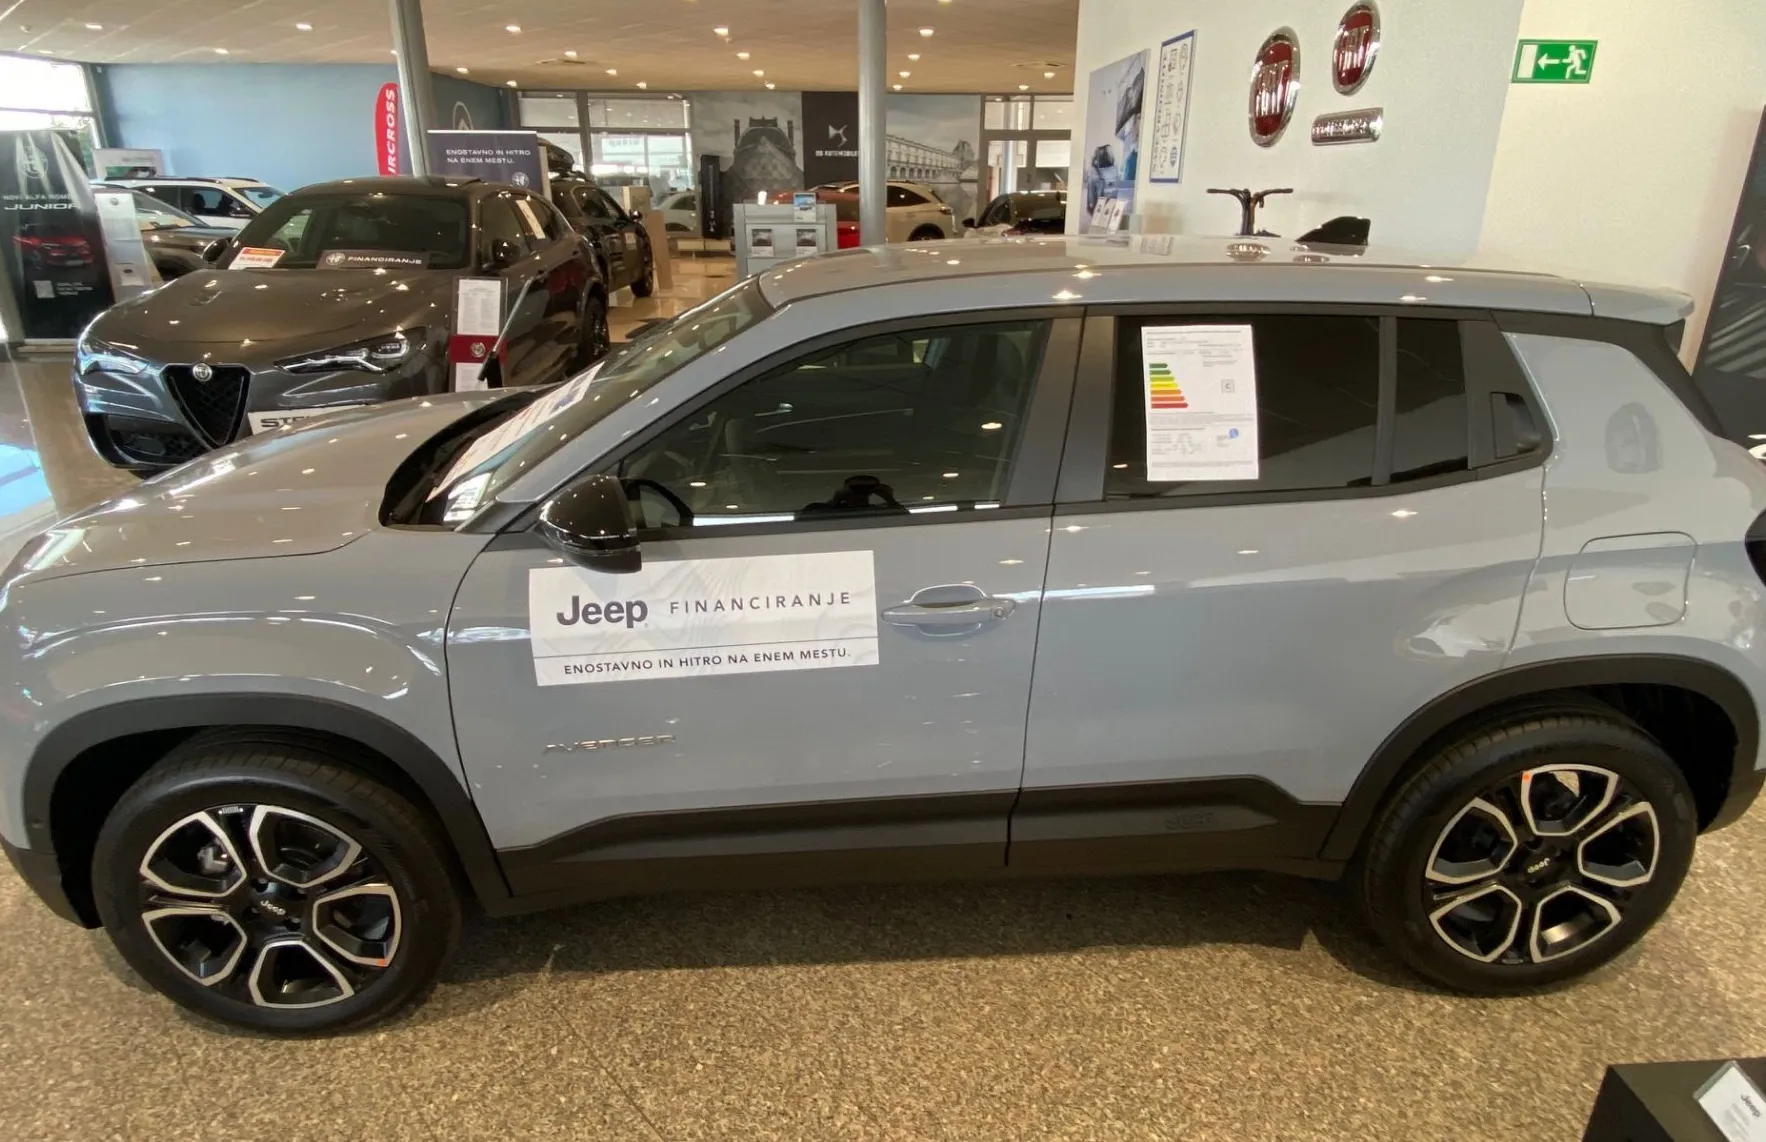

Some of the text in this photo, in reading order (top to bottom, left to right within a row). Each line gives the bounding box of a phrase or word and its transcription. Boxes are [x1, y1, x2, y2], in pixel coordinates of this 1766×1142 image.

[386, 89, 397, 175] IRCROSS
[556, 591, 851, 629] Jeep FINANCIRANJE
[564, 647, 851, 675] ENOSTAVNO IN HITRO NA ENEM MESTU.
[542, 734, 676, 755] AVENGER
[260, 900, 287, 916] Jeep
[1740, 1093, 1761, 1118] Jeep
